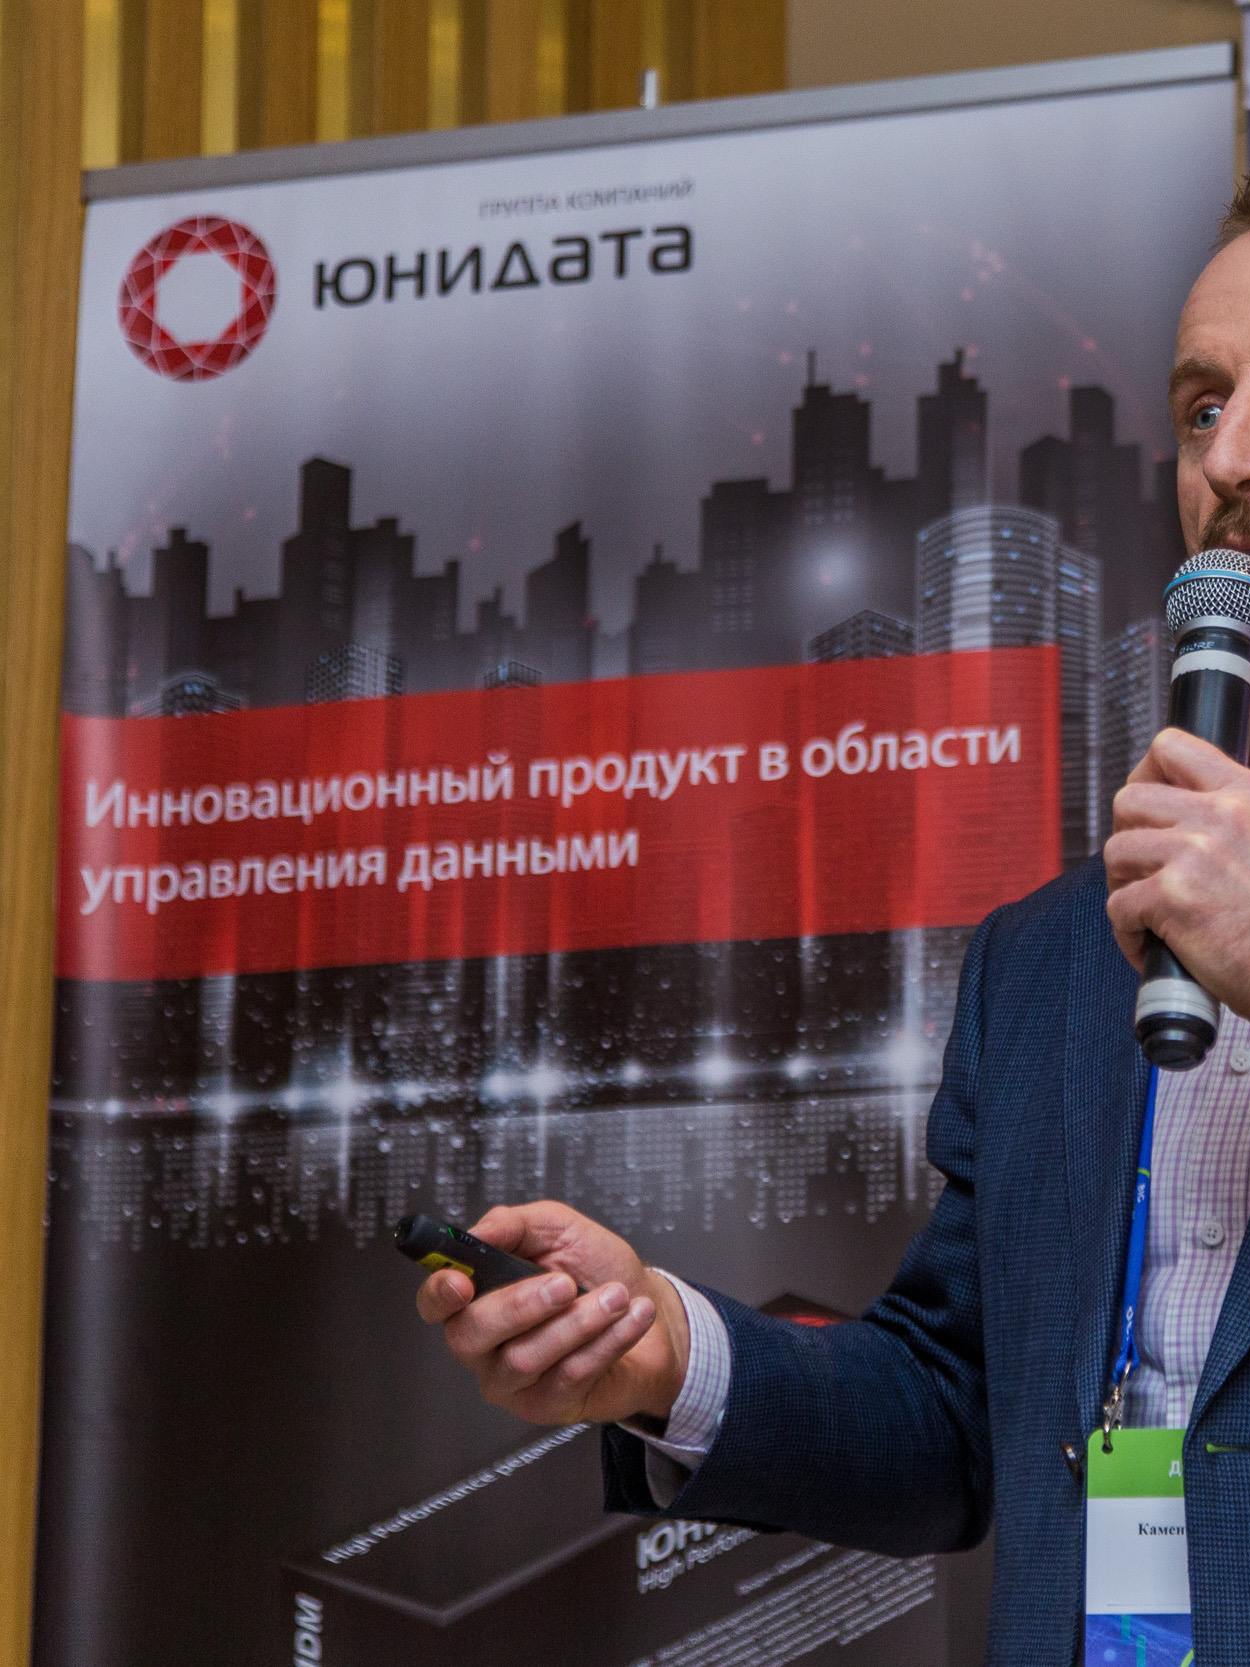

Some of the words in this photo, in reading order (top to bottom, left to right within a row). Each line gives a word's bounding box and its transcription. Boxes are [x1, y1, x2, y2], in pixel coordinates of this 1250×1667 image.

[479, 193, 560, 220] ГРУППА
[563, 178, 693, 211] КОМПАНИЙ
[84, 749, 516, 829] Инновационный
[527, 742, 748, 809] продукт
[757, 740, 790, 782] в
[801, 720, 1022, 779] области
[78, 847, 388, 917] управления
[396, 827, 641, 894] данными
[320, 1533, 379, 1565] High
[368, 1466, 498, 1539] Performance
[636, 1519, 718, 1570] ЮН
[637, 1556, 686, 1595] High
